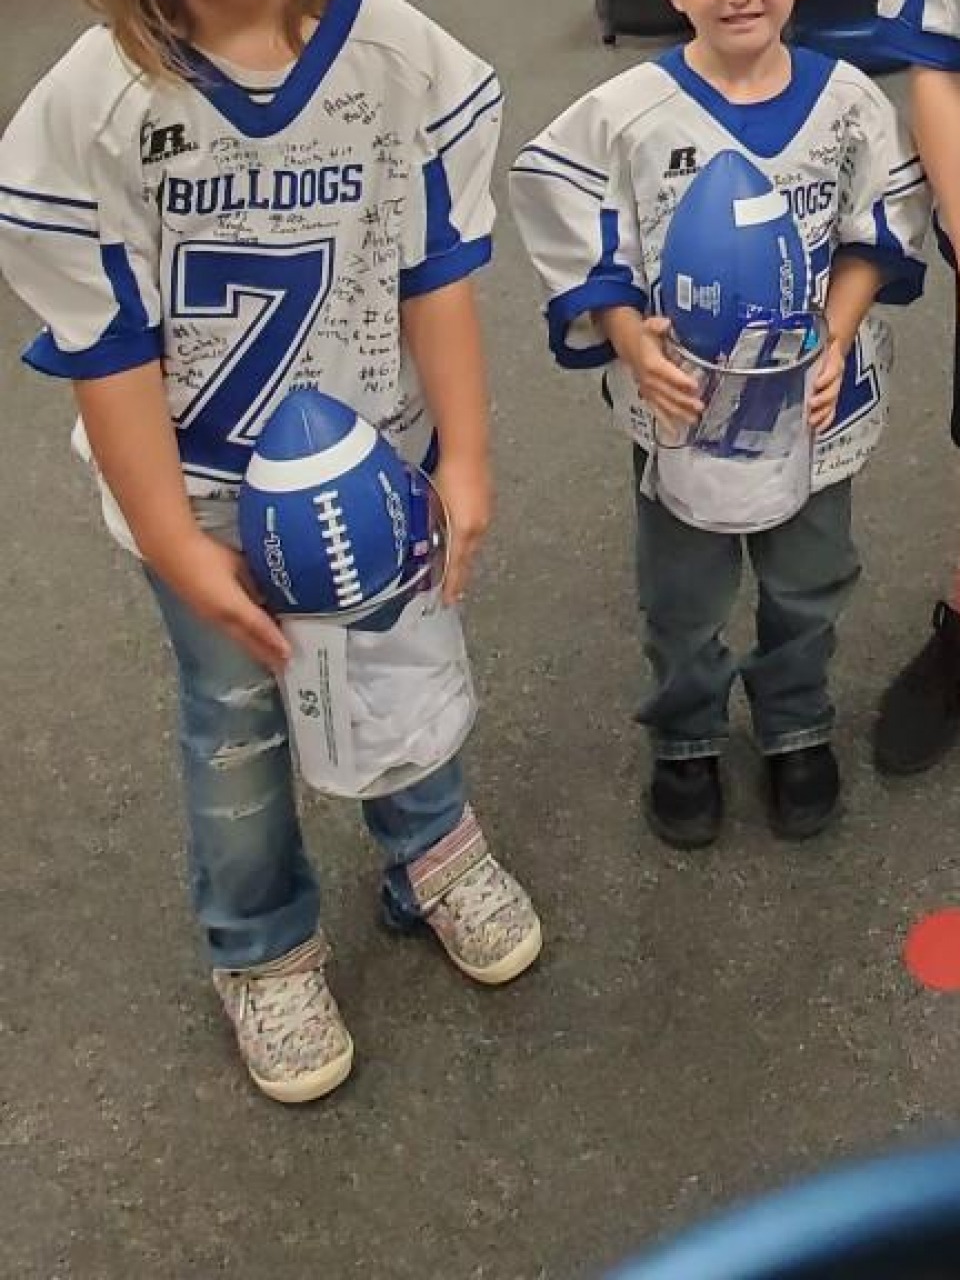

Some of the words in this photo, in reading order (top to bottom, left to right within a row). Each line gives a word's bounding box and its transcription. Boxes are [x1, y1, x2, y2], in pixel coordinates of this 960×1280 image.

[166, 164, 363, 216] BULLDOGS
[171, 238, 336, 477] 7
[297, 686, 321, 720] $5
